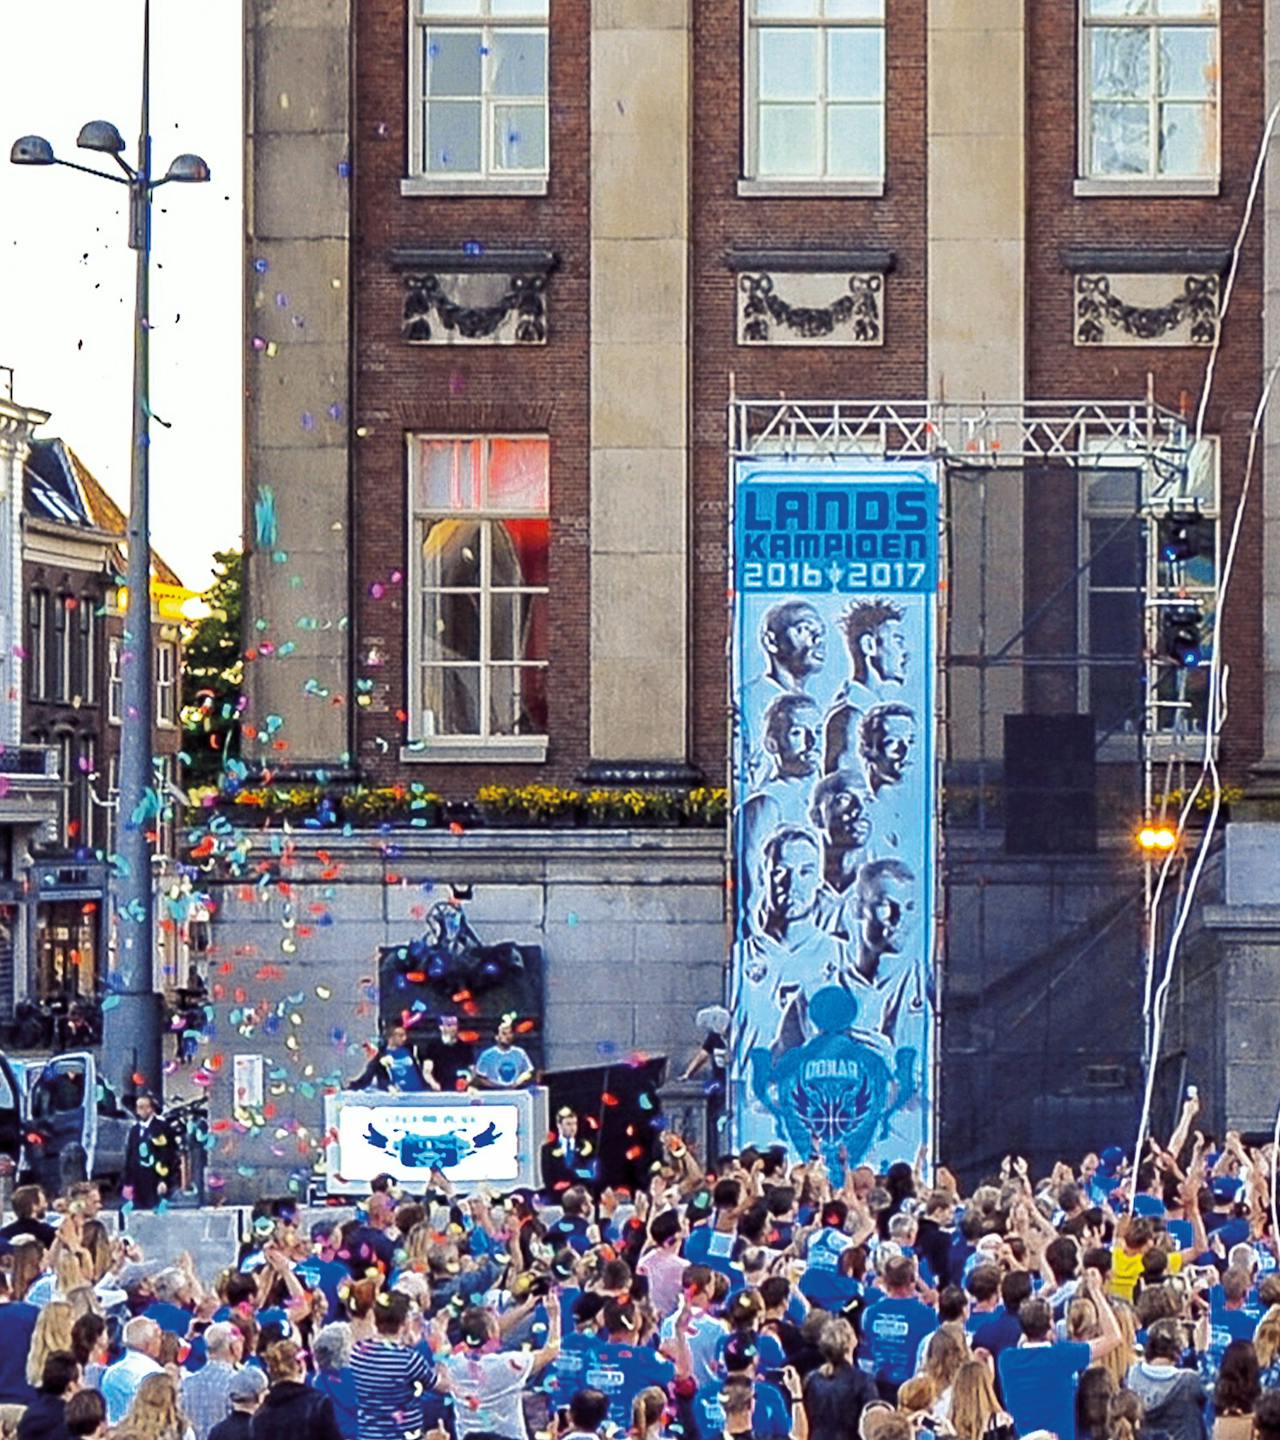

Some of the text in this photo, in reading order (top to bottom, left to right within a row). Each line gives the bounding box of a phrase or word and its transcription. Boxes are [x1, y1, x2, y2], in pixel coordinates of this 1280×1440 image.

[745, 491, 927, 531] LANDS
[745, 534, 926, 559] KAMPIOEN
[743, 562, 925, 588] 2016 2017
